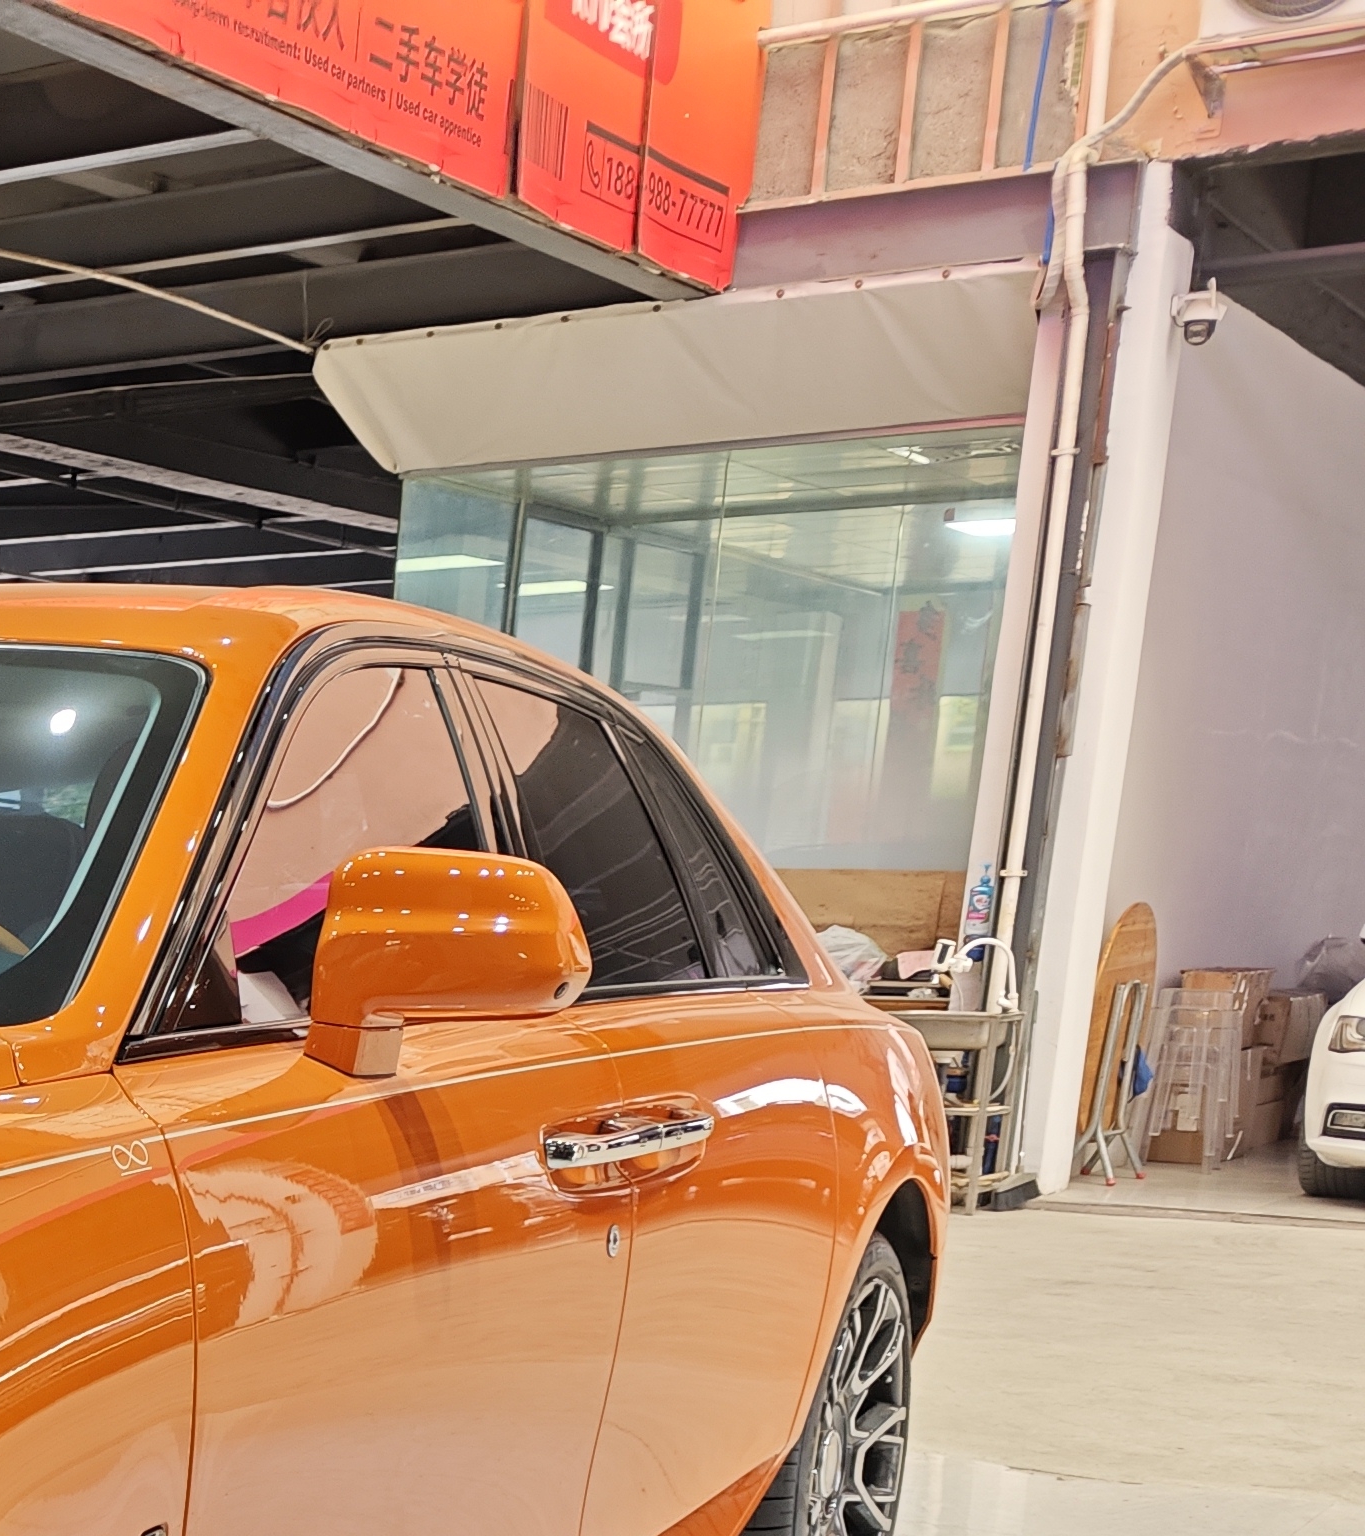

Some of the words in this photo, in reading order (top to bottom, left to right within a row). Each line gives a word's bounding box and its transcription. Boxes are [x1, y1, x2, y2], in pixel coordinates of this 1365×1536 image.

[304, 46, 329, 74] Used
[330, 63, 346, 83] car
[346, 71, 386, 103] partners
[395, 91, 421, 117] Used
[422, 108, 438, 126] car
[439, 116, 482, 148] apprentice
[368, 16, 489, 122] 二手车学徒
